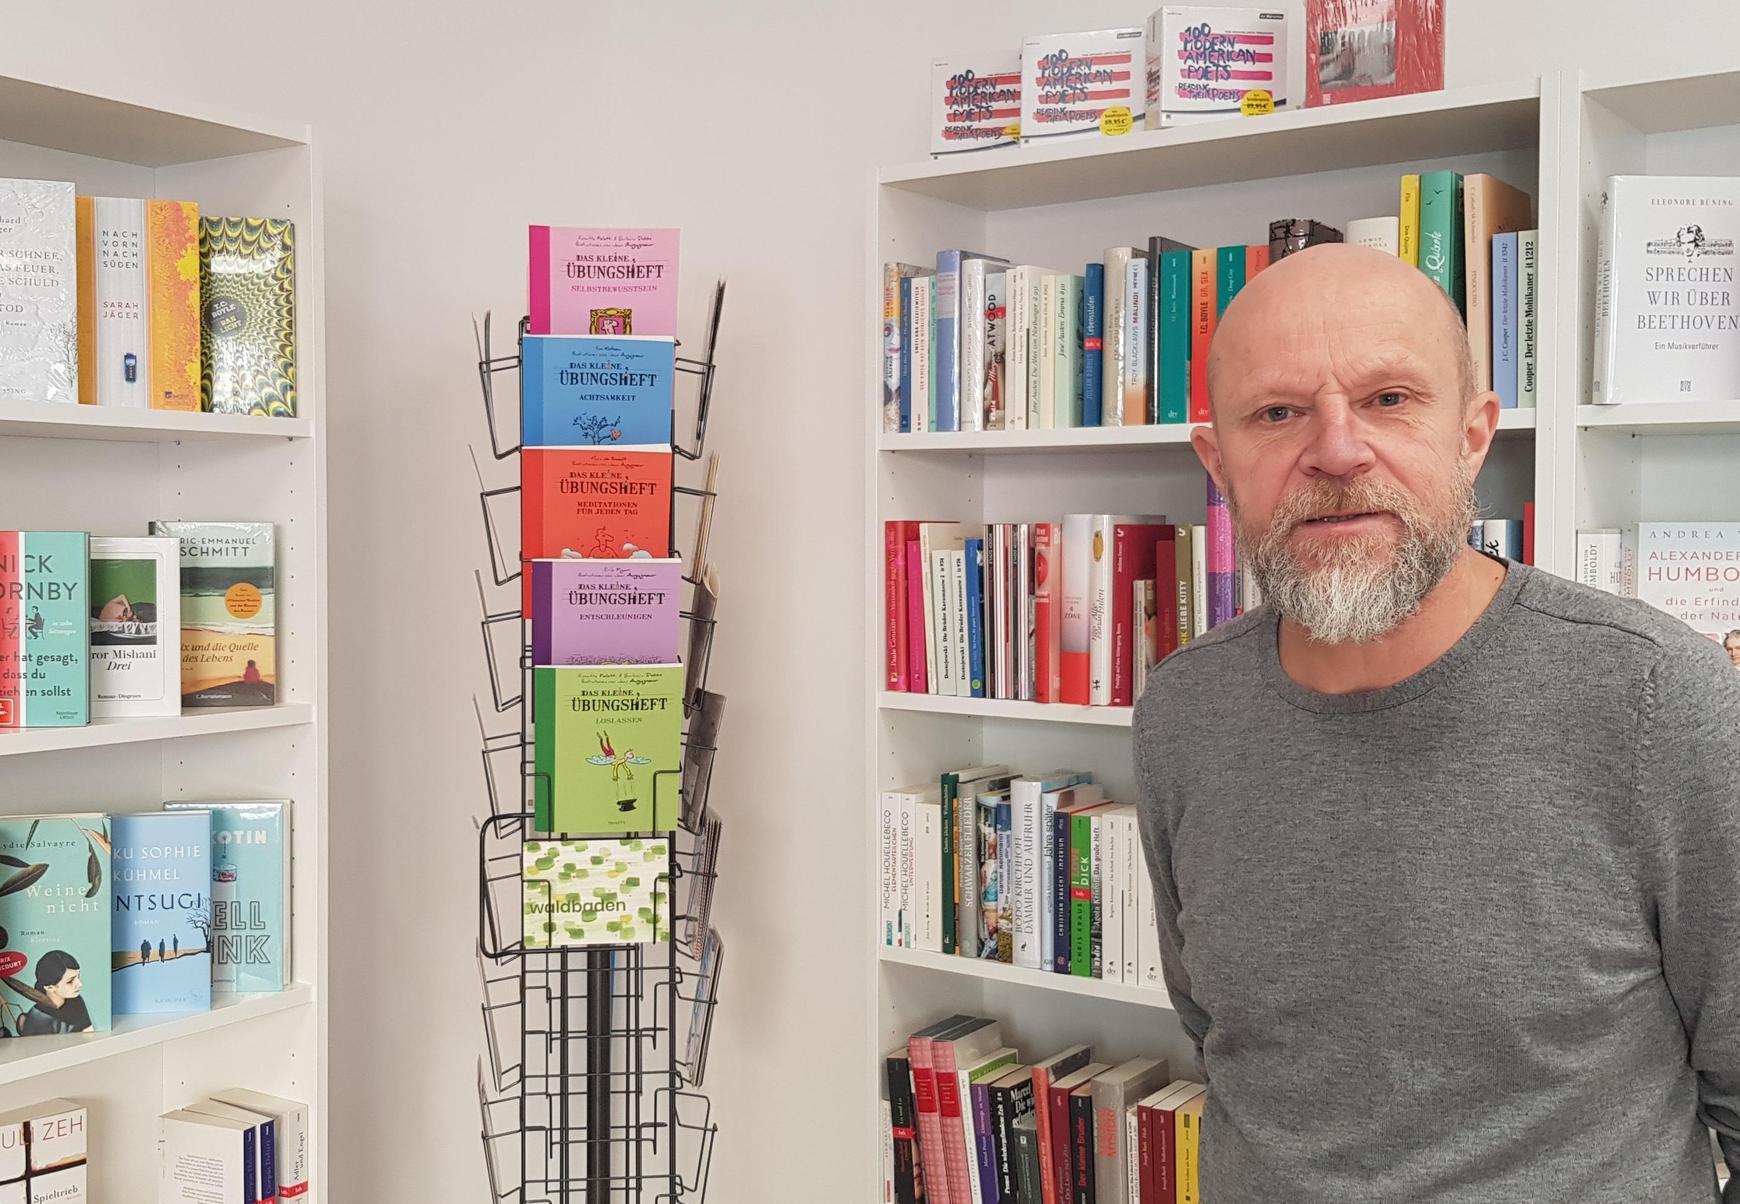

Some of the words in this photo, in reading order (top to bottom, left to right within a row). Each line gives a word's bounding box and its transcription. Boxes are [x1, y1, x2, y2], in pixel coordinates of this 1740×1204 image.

[1185, 23, 1211, 39] 100
[1184, 37, 1236, 51] MODERN
[1043, 49, 1068, 63] 100
[1184, 49, 1255, 65] AMERICAN
[1042, 59, 1093, 79] MODERN
[1188, 64, 1232, 82] POETS
[951, 70, 974, 85] 100
[1042, 70, 1113, 90] AMERICAN
[950, 79, 997, 97] MODERN
[1046, 86, 1088, 104] POETS
[950, 88, 1016, 109] AMERICAN
[953, 104, 993, 123] POETS
[102, 230, 138, 238] NACH
[103, 240, 138, 248] VORN
[1525, 241, 1534, 260] 1212
[103, 250, 138, 258] NACH
[597, 252, 629, 262] KLEINE
[103, 260, 138, 269] SÜDEN
[567, 262, 664, 279] ÜBUNGSHEFT
[1645, 266, 1734, 283] SPRECHEN
[571, 284, 658, 293] SELBSTBEWUSSTSEIN
[1524, 272, 1534, 317] Mohikaner
[1601, 259, 1611, 317] BEETHOVEN
[103, 301, 139, 309] SARAH
[1647, 291, 1681, 306] WIR
[1688, 289, 1731, 306] ÜBER
[103, 310, 139, 319] JÄGER
[212, 304, 236, 318] BOYLE
[1058, 297, 1066, 319] Emma
[1087, 296, 1095, 336] Lebensstufen
[1200, 301, 1208, 322] BOYLE
[987, 294, 997, 347] ATWOOD
[1637, 314, 1739, 330] BEETHOVEN
[1502, 328, 1510, 349] Cooper
[1524, 319, 1534, 342] letzte
[1058, 342, 1067, 358] Jane
[1524, 343, 1533, 358] Der
[1655, 342, 1665, 350] Ein
[1668, 342, 1719, 351] Musikverführer
[590, 360, 622, 370] KLEINE
[560, 369, 657, 386] ÜBUNGSHEFT
[1524, 362, 1535, 392] Cooper
[590, 470, 622, 479] KLEINE
[560, 479, 657, 495] ÜBUNGSHEFT
[1650, 530, 1724, 538] ANDREA
[180, 547, 250, 557] SCHMITT
[1649, 567, 1740, 581] HUMBO
[599, 581, 632, 590] KLEINE
[1179, 580, 1187, 604] KITTY
[569, 591, 665, 605] ÜBUNGSHEFT
[1666, 597, 1687, 606] die
[1695, 597, 1739, 606] Erfind
[1179, 605, 1188, 629] LIEBE
[1681, 611, 1703, 620] der
[111, 649, 156, 660] Mishani
[192, 643, 209, 652] und
[212, 643, 227, 652] die
[229, 643, 259, 652] Quelle
[14, 652, 33, 662] hat
[37, 653, 78, 666] gesagt,
[107, 660, 131, 671] Drei
[183, 654, 198, 663] des
[200, 654, 233, 663] Lebens
[3, 668, 28, 679] dass
[31, 668, 46, 679] du
[41, 685, 71, 697] sollst
[602, 687, 634, 697] KLEINE
[572, 697, 667, 712] ÜBUNGSHEFT
[963, 797, 973, 841] FLIEDER
[1044, 804, 1054, 833] später
[1023, 803, 1033, 855] AUFRUHR
[1092, 827, 1100, 842] Heft
[30, 839, 76, 849] Salvayre
[883, 810, 891, 874] HOUELLEBECQ
[1044, 834, 1053, 859] Jahre
[114, 848, 133, 860] KU
[142, 846, 200, 859] SOPHIE
[1093, 843, 1101, 863] große
[1015, 835, 1023, 897] KIRCHHOFF
[1024, 858, 1033, 884] UND
[1080, 857, 1089, 886] DICK
[114, 868, 180, 881] KÜHMEL
[963, 843, 974, 907] SCHWARZER
[26, 884, 87, 898] Weine
[883, 876, 891, 910] MICHEL
[47, 900, 100, 914] nicht
[116, 893, 202, 912] NTSUGI
[529, 900, 626, 914] waldbaden
[1023, 887, 1033, 934] DÄMMER
[1015, 900, 1023, 933] BODO
[42, 1115, 82, 1141] ZEH
[1077, 1117, 1085, 1144] Bruder
[1079, 1172, 1087, 1186] Der
[34, 1185, 79, 1204] Spieltrieb
